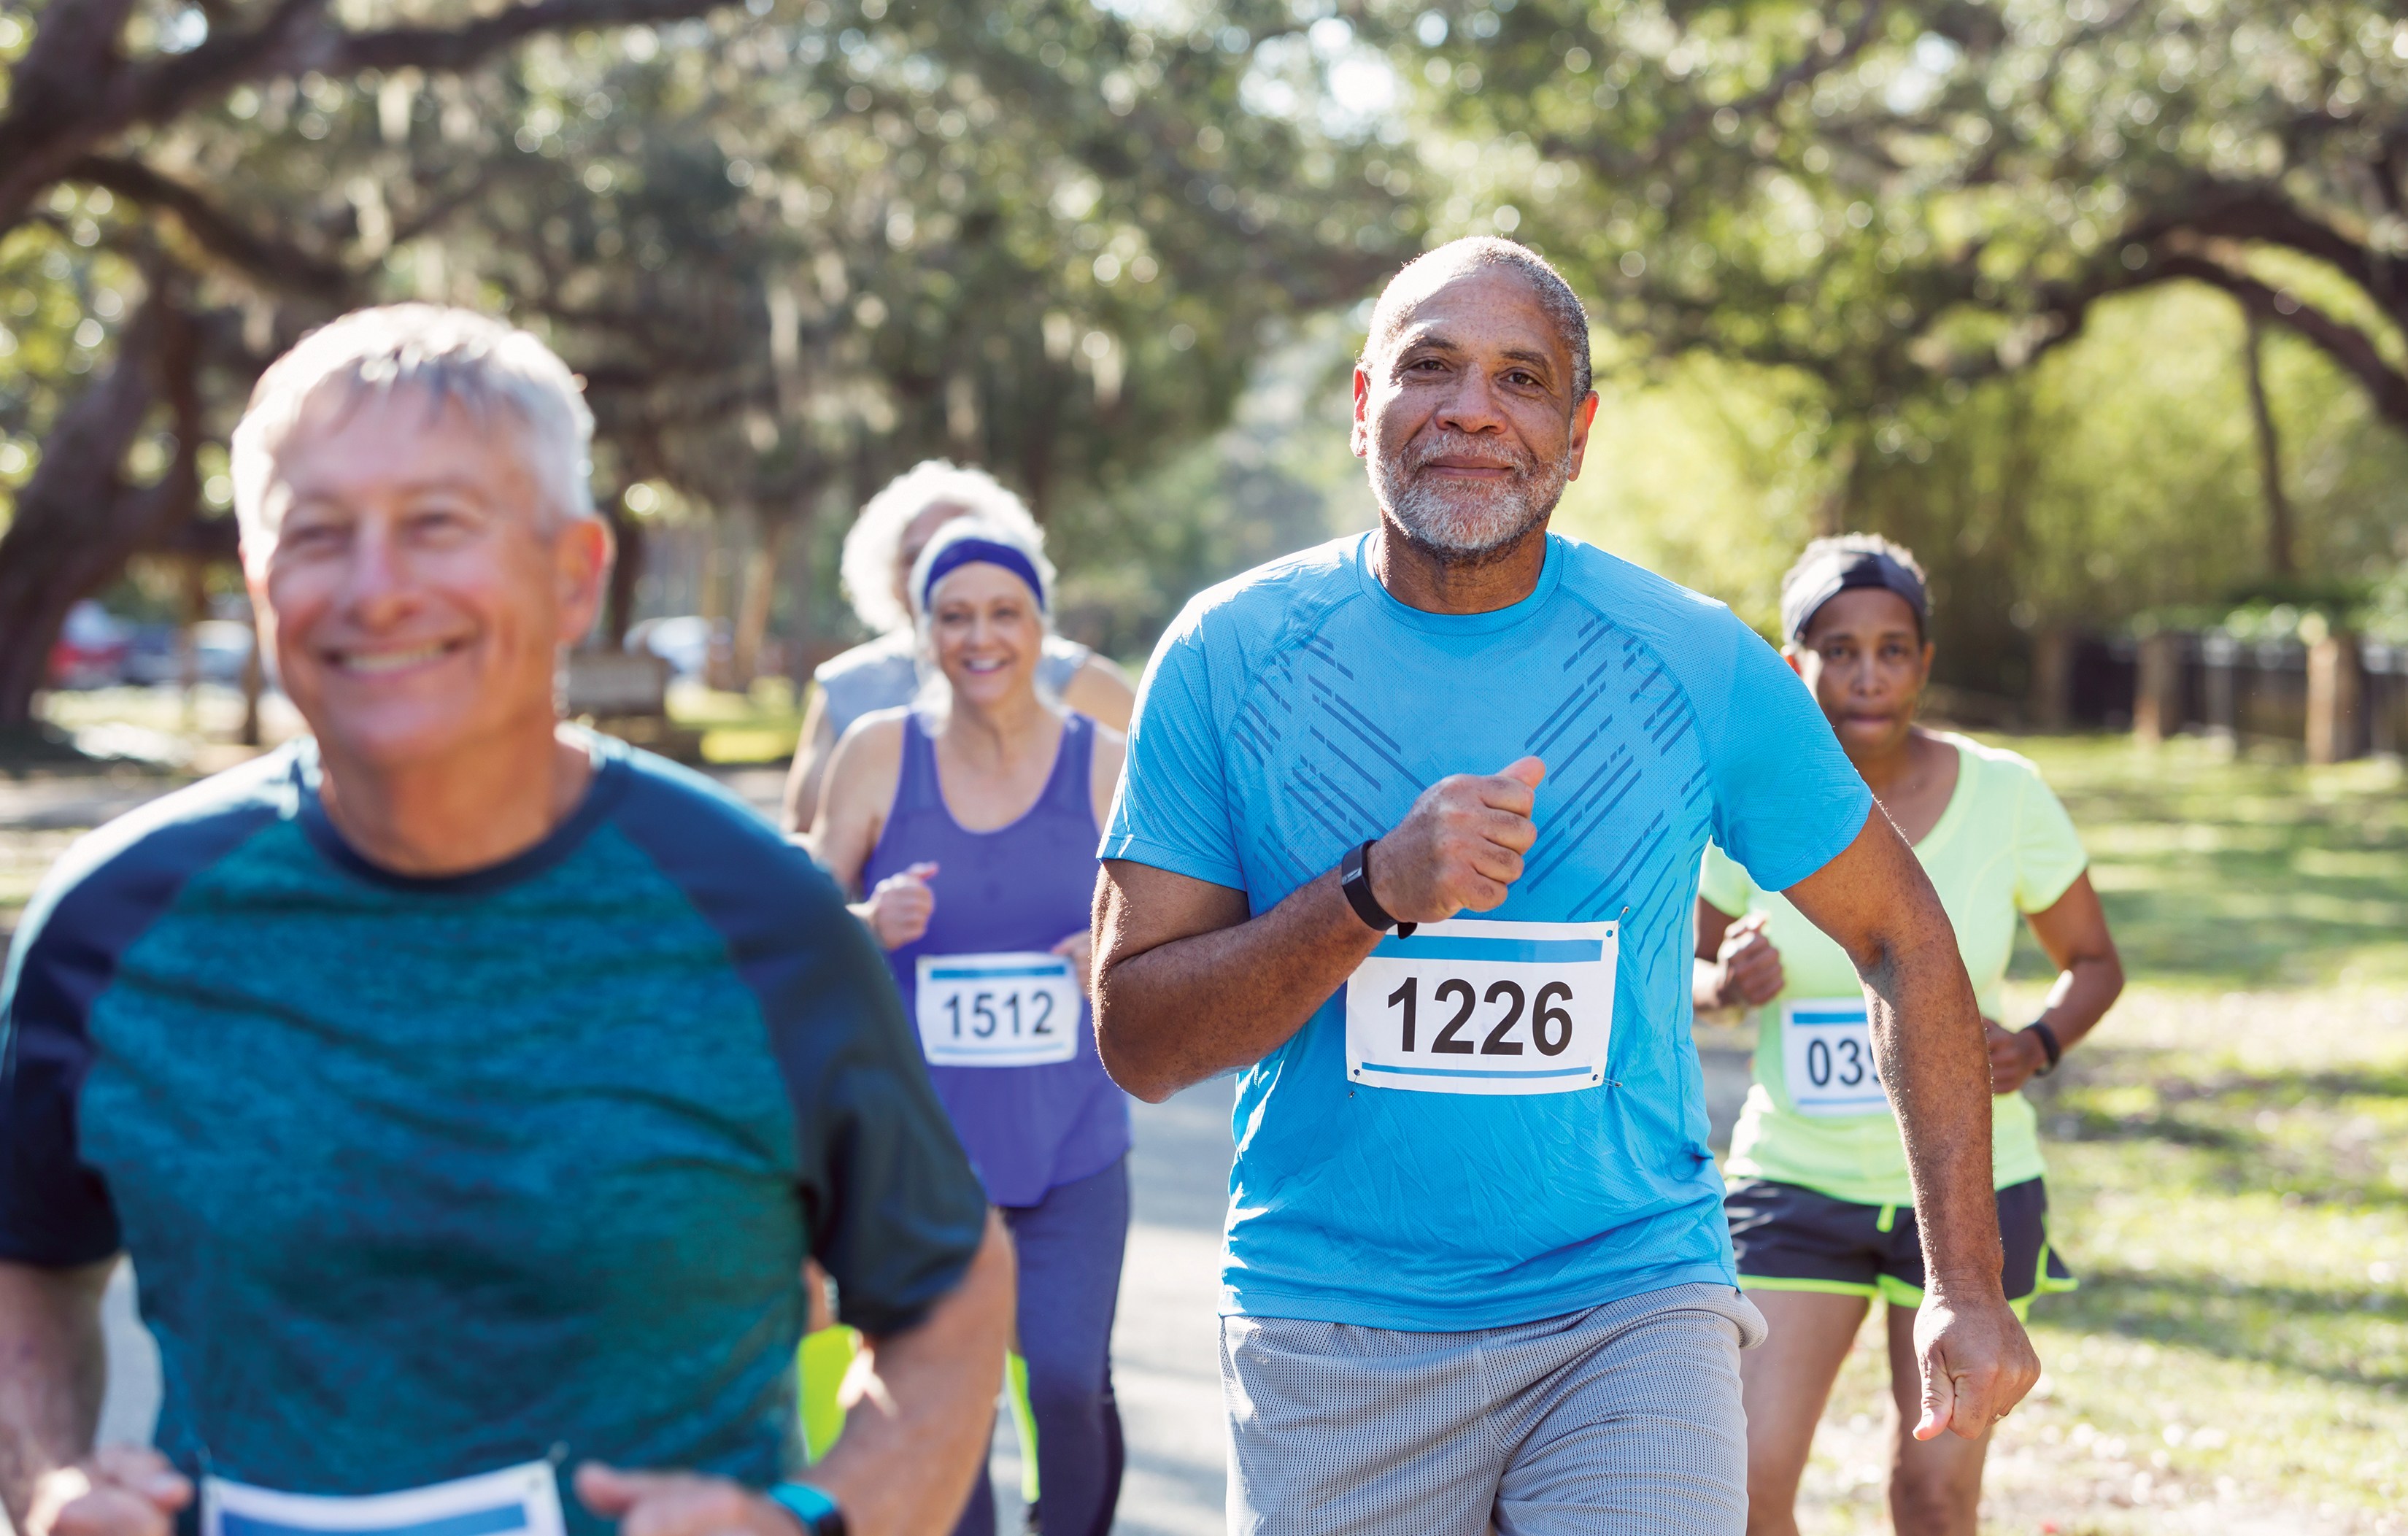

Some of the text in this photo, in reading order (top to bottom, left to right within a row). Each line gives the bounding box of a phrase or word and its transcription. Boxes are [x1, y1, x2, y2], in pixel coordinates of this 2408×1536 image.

[944, 990, 1054, 1038] 1512
[1388, 976, 1573, 1057] 1226
[1808, 1038, 1881, 1087] 03
